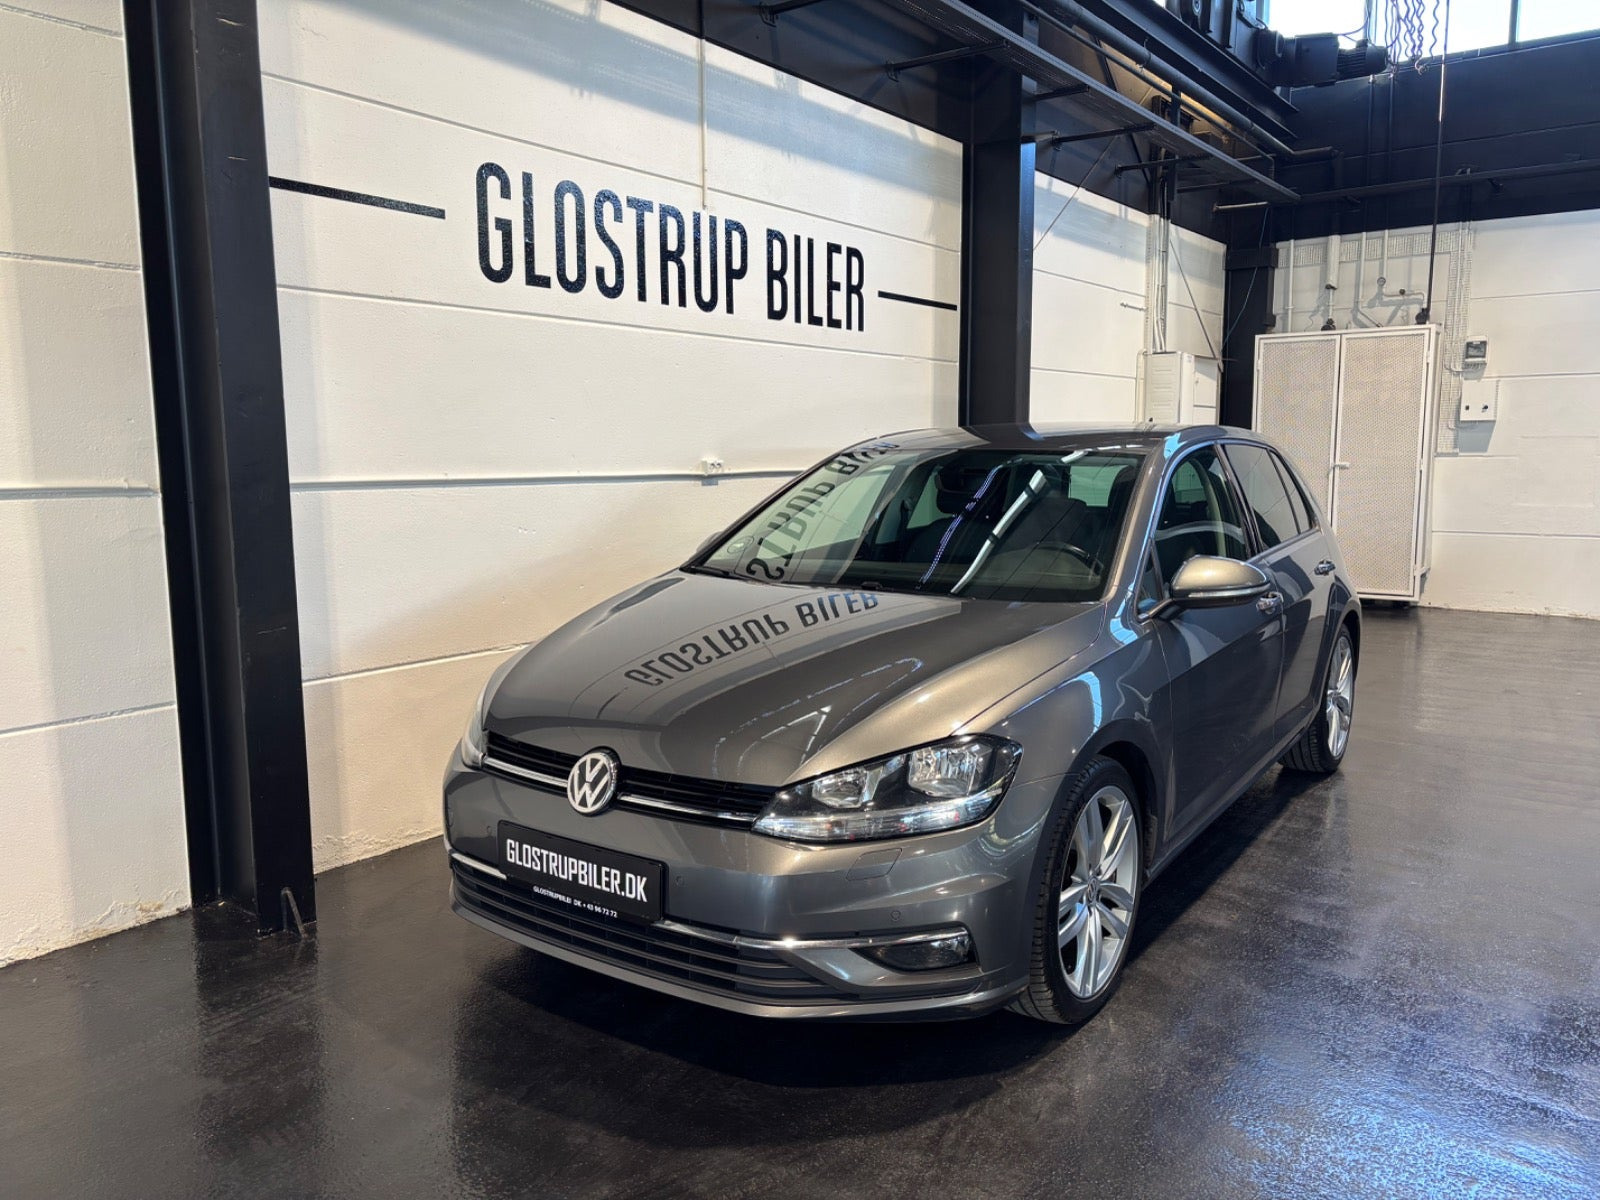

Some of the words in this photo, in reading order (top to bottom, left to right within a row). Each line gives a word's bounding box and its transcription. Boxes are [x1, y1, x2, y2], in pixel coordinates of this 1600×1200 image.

[475, 161, 748, 314] GLOSTRUP
[766, 228, 865, 332] BILER
[568, 753, 612, 812] VW
[506, 838, 648, 902] GLOSTRUPBILER.DK
